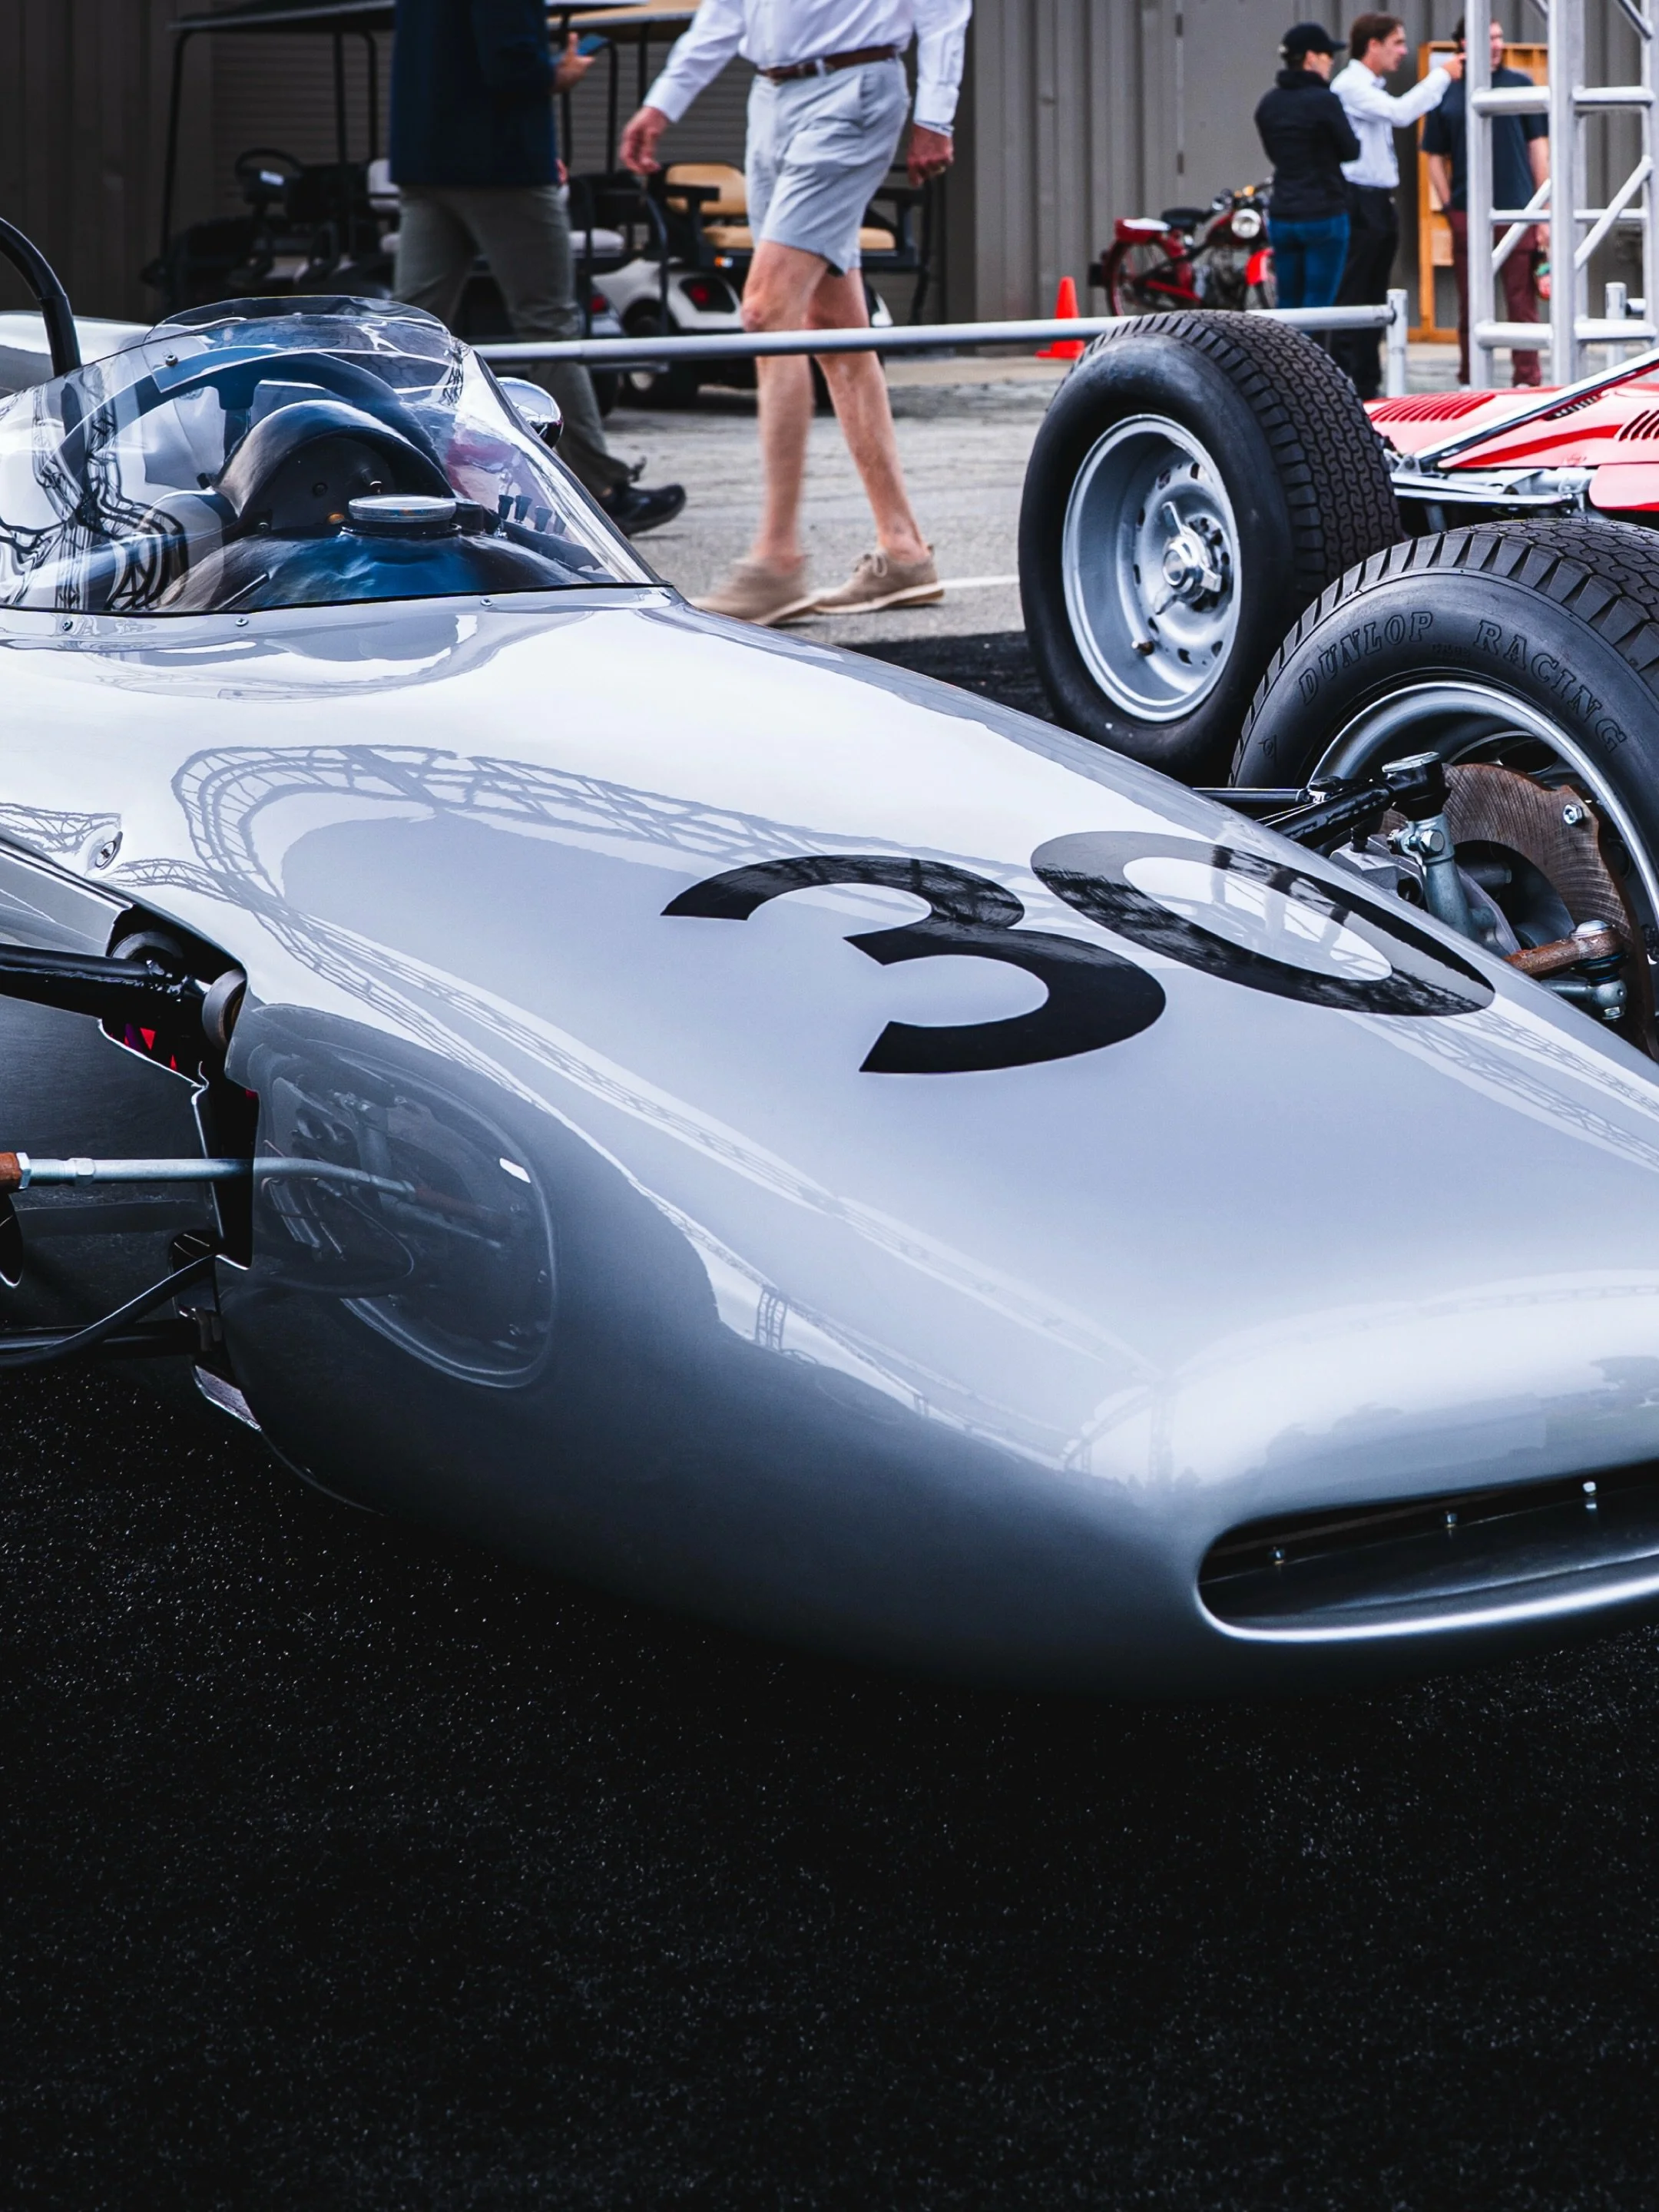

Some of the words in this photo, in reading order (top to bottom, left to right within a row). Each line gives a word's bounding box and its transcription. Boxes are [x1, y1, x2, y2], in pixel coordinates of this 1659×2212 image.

[1299, 611, 1433, 705] DUNLOP
[1474, 620, 1628, 753] RACING
[661, 831, 1495, 1074] 30
